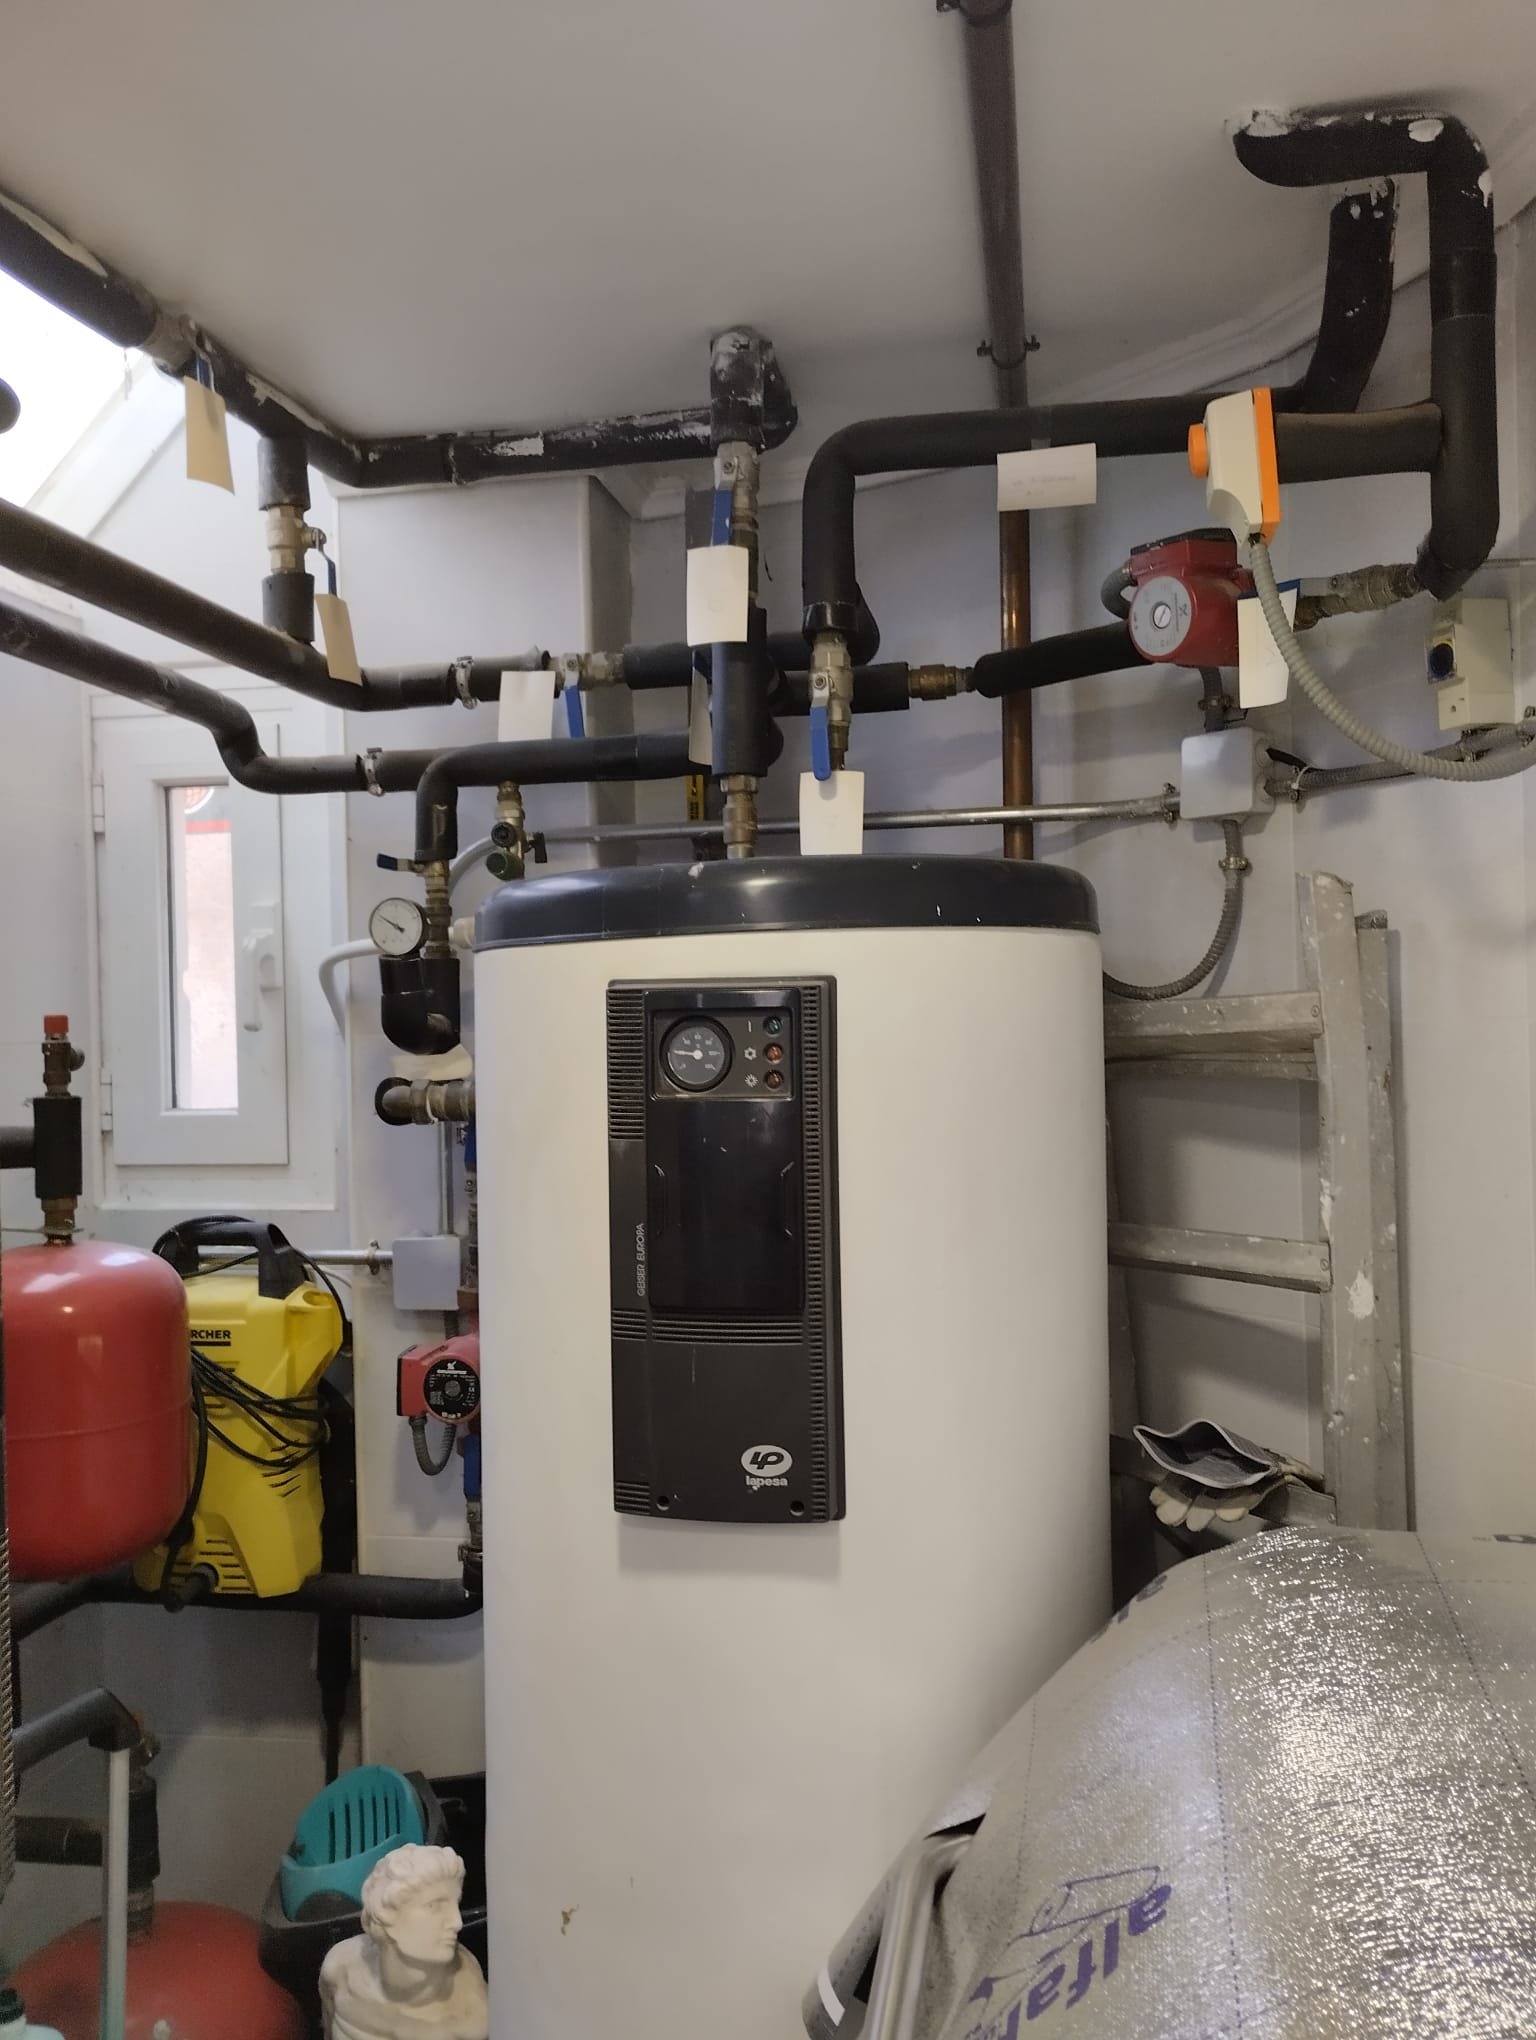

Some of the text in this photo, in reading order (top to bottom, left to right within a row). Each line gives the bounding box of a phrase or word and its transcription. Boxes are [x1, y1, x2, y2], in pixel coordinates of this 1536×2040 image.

[635, 1223, 646, 1261] EUROPA
[190, 1329, 232, 1340] RCHER
[745, 1475, 788, 1488] lapesa
[1000, 1885, 1172, 2040] alfa
